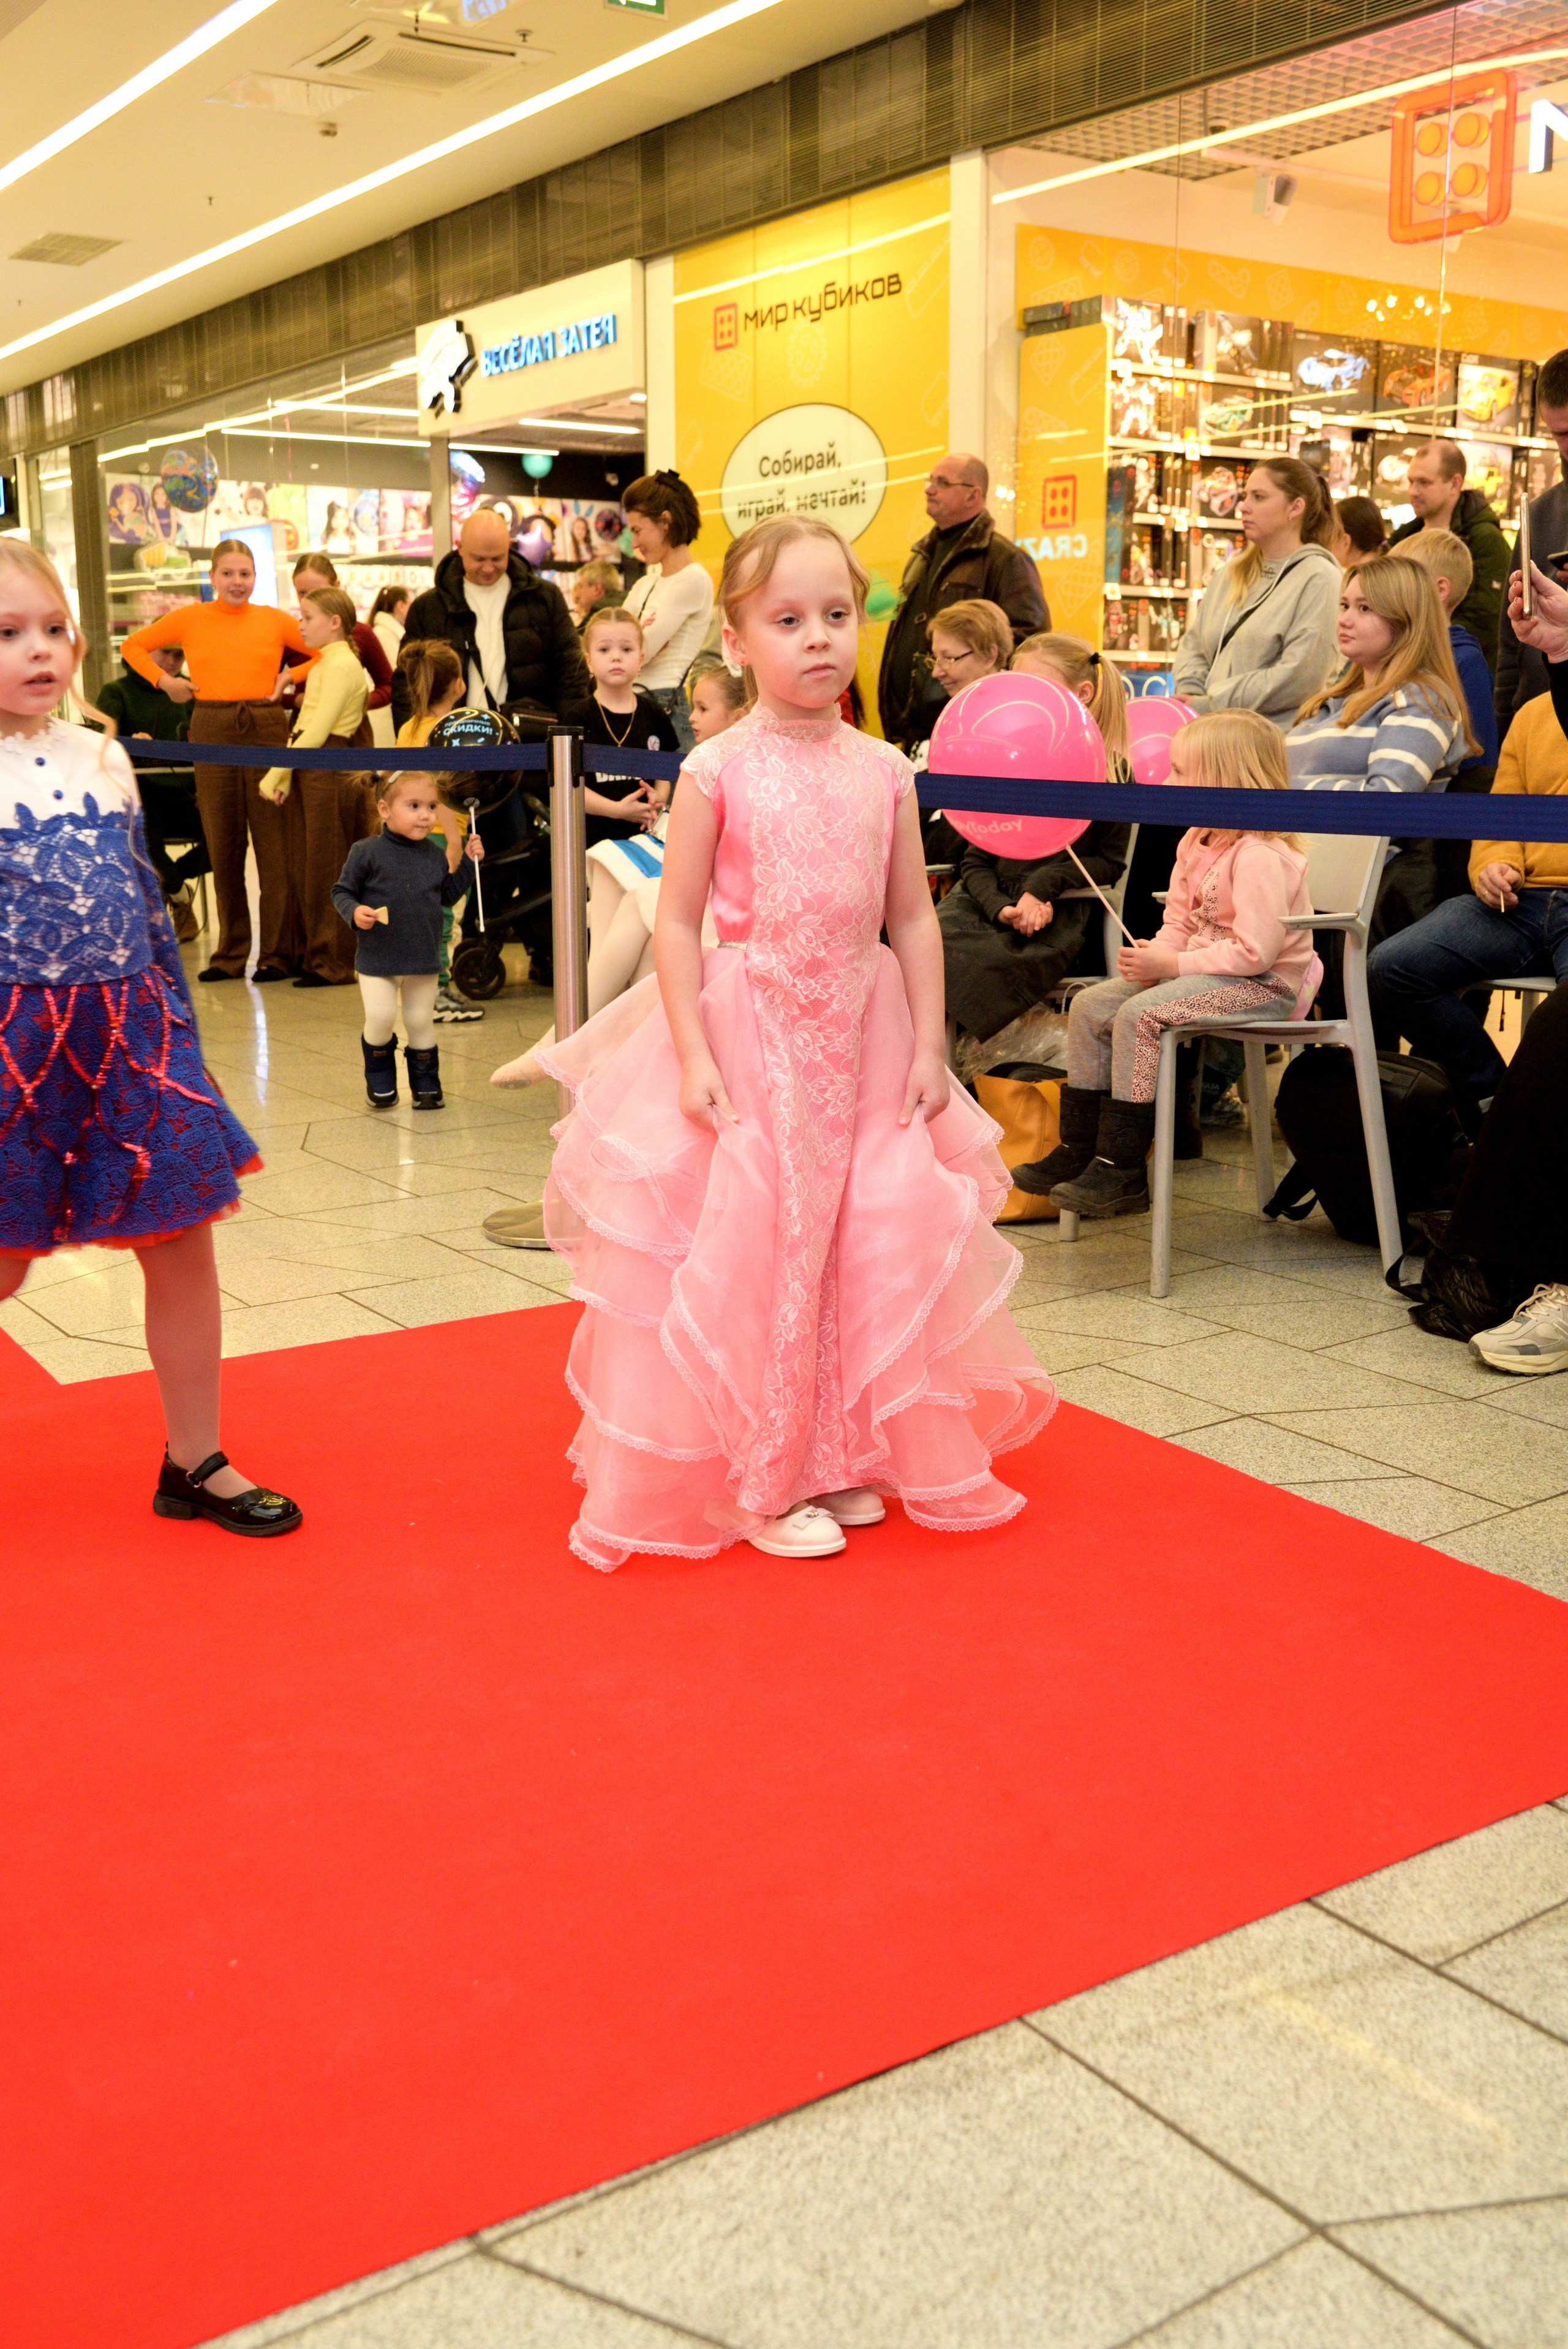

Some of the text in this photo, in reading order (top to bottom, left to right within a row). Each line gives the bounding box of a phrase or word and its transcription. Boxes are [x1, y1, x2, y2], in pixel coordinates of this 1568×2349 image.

[744, 273, 902, 331] мир кубиков
[480, 312, 617, 377] ВЕСЁЛАЯ ЗАТЕЯ
[759, 441, 842, 477] Собирай,
[796, 478, 865, 512] мечтай!
[442, 724, 493, 736] СКИДКИ!
